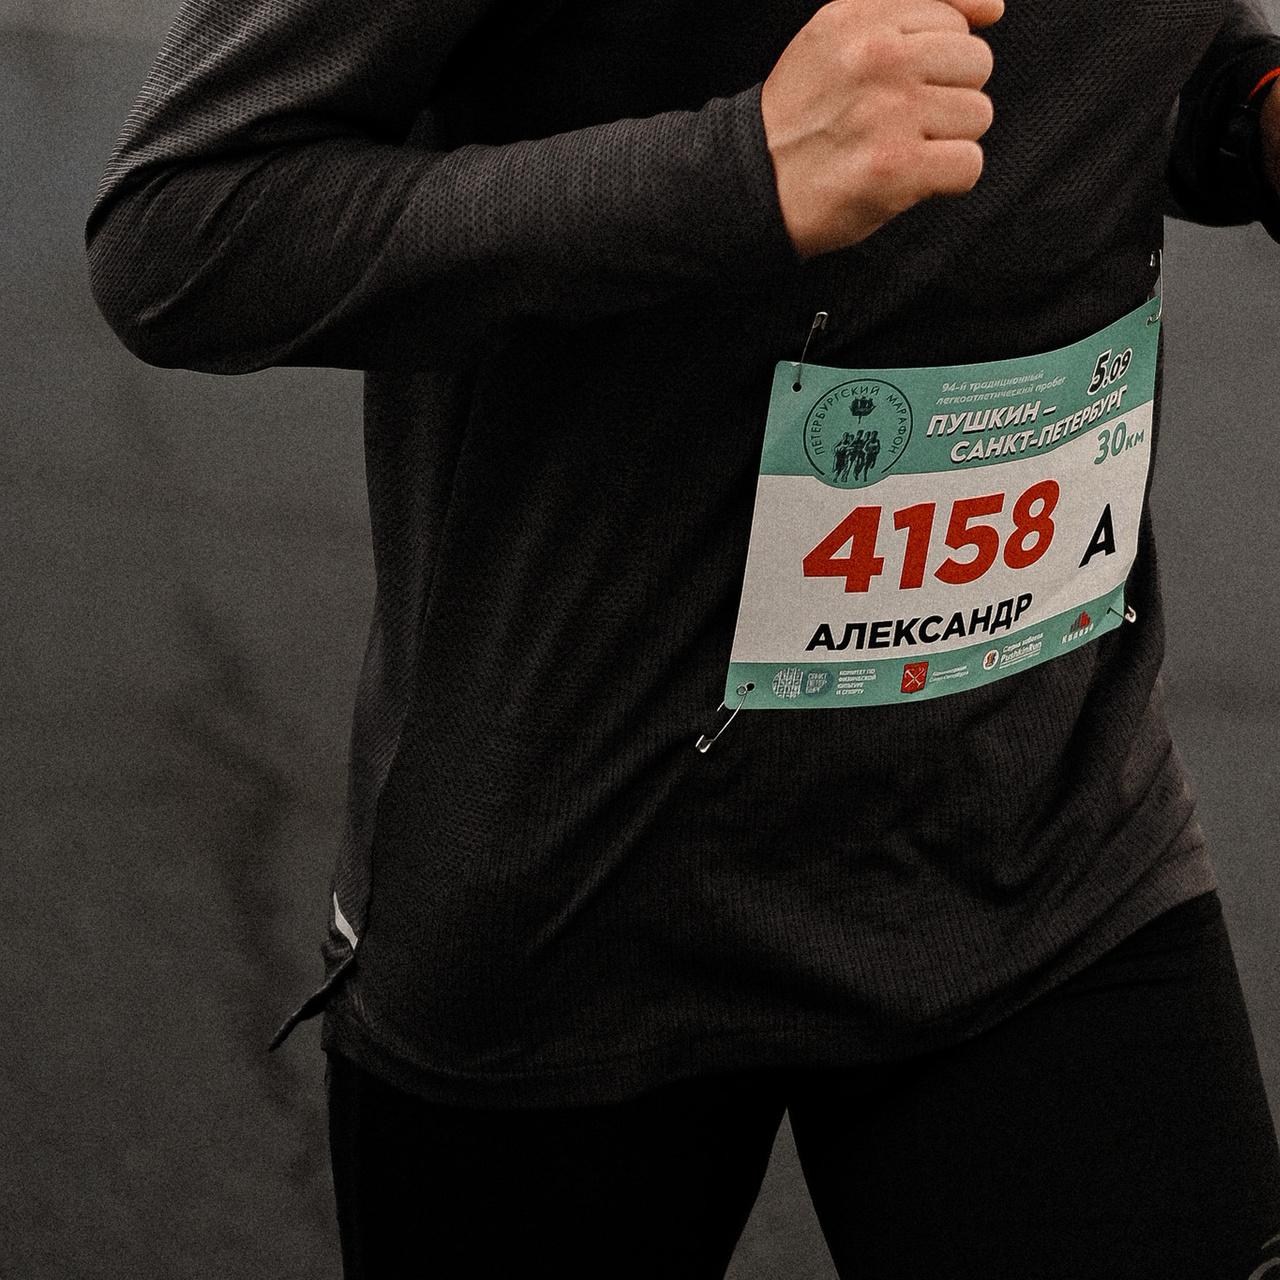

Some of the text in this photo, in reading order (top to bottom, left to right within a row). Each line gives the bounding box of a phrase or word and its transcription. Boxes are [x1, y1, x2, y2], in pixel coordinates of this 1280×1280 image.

[935, 376, 1067, 405] легкоатлетический пробег
[941, 369, 1045, 393] 94-й традиционный
[1087, 347, 1133, 396] 5.09
[810, 385, 908, 456] ПЕТЕРБУРГСКИЙ МАРАФОН
[926, 400, 1042, 437] ПУШКИН
[950, 384, 1128, 463] САНКТ-ПЕТЕРБУРГ
[802, 479, 1061, 594] 4158
[805, 592, 1034, 653] АЛЕКСАНДР
